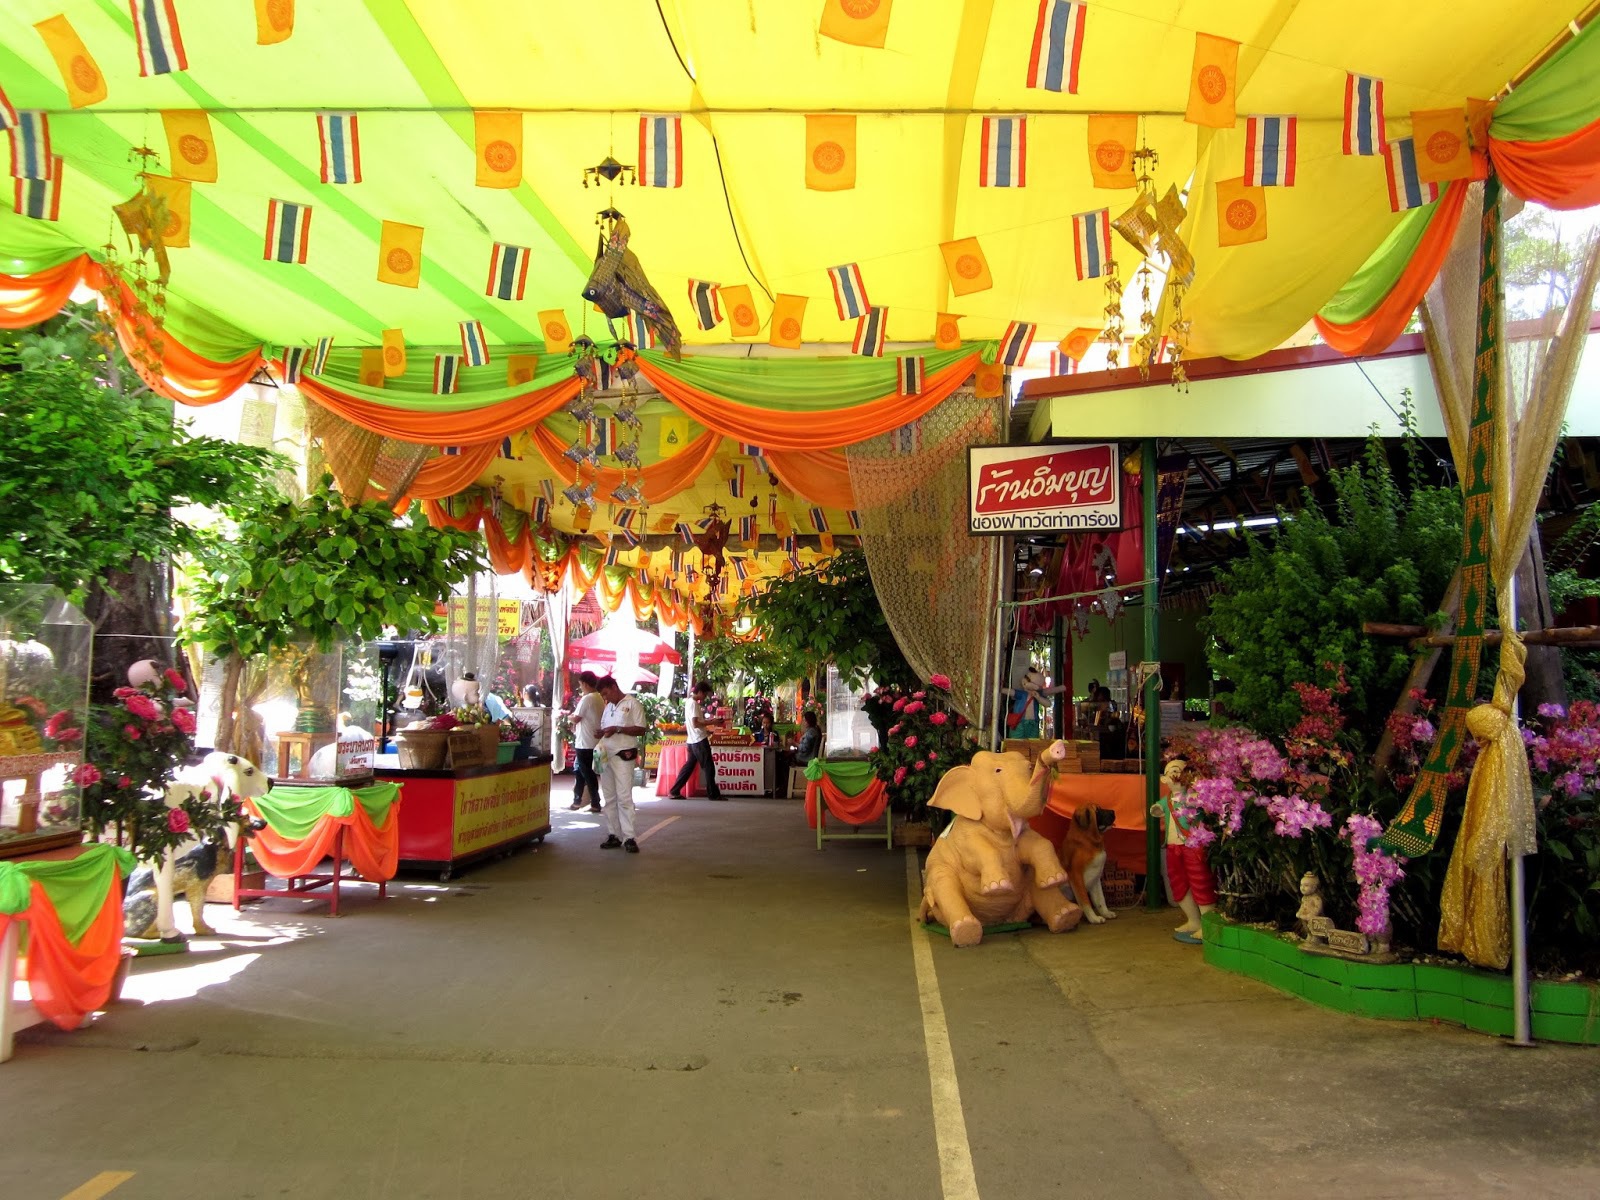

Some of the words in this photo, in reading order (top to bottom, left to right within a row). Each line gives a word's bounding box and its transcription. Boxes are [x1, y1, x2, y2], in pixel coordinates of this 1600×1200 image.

[979, 457, 1110, 505] ร้านอิ่มบุญ
[972, 510, 1119, 530] ของฝากวัดท่าการ้อง
[717, 765, 755, 777] รับแลก
